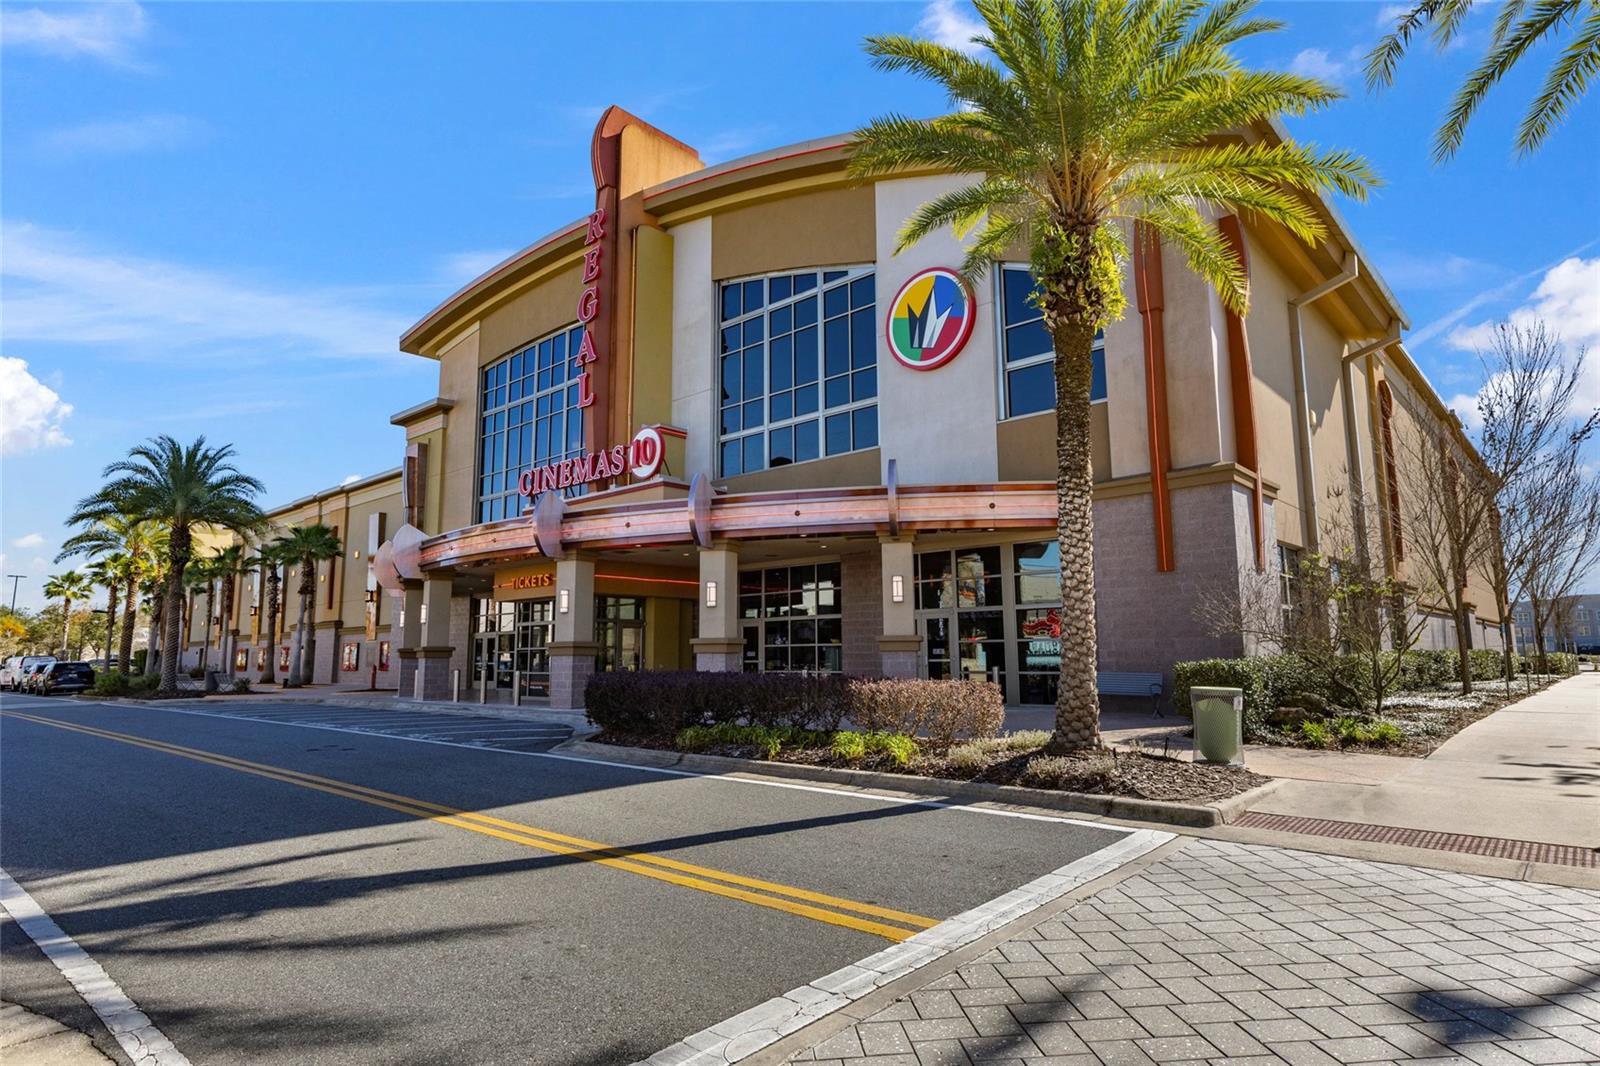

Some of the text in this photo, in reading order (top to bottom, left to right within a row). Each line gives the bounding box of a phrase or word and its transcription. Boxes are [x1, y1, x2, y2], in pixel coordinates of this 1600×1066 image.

[576, 207, 607, 409] REGAL
[518, 436, 657, 497] CINEMAS 10
[511, 573, 551, 589] TICKETS
